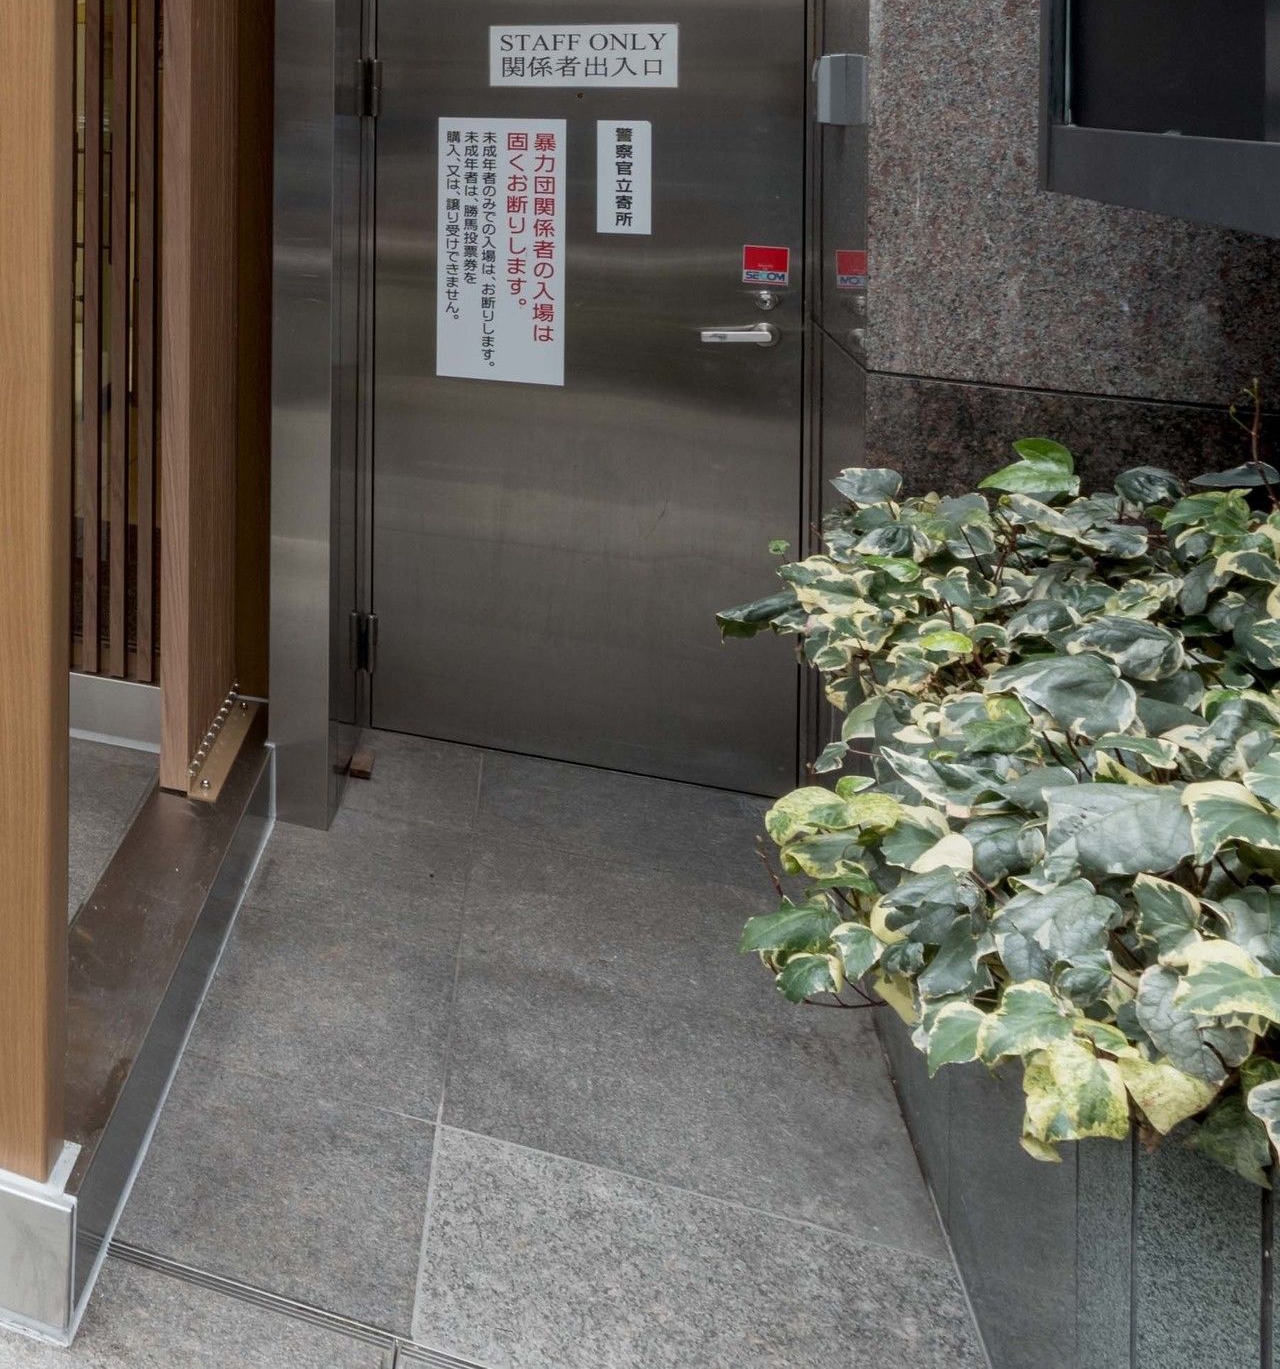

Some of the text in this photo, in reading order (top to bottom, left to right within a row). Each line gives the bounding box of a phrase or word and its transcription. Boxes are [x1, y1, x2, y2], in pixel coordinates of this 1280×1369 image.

[500, 32, 668, 51] STAFF ONLY
[501, 56, 663, 78] 関係者出入口
[445, 130, 462, 321] 購入、又は、譲り受けできません。
[463, 130, 479, 285] 未成年者は、勝馬投票券を
[480, 130, 498, 367] 未成年者のみでの入場は、お断りします。
[506, 131, 529, 309] 固くお断りします。
[532, 132, 557, 343] 暴力団関係者の入場は
[614, 127, 634, 228] 警察官立寄所
[745, 271, 785, 282] SECOM
